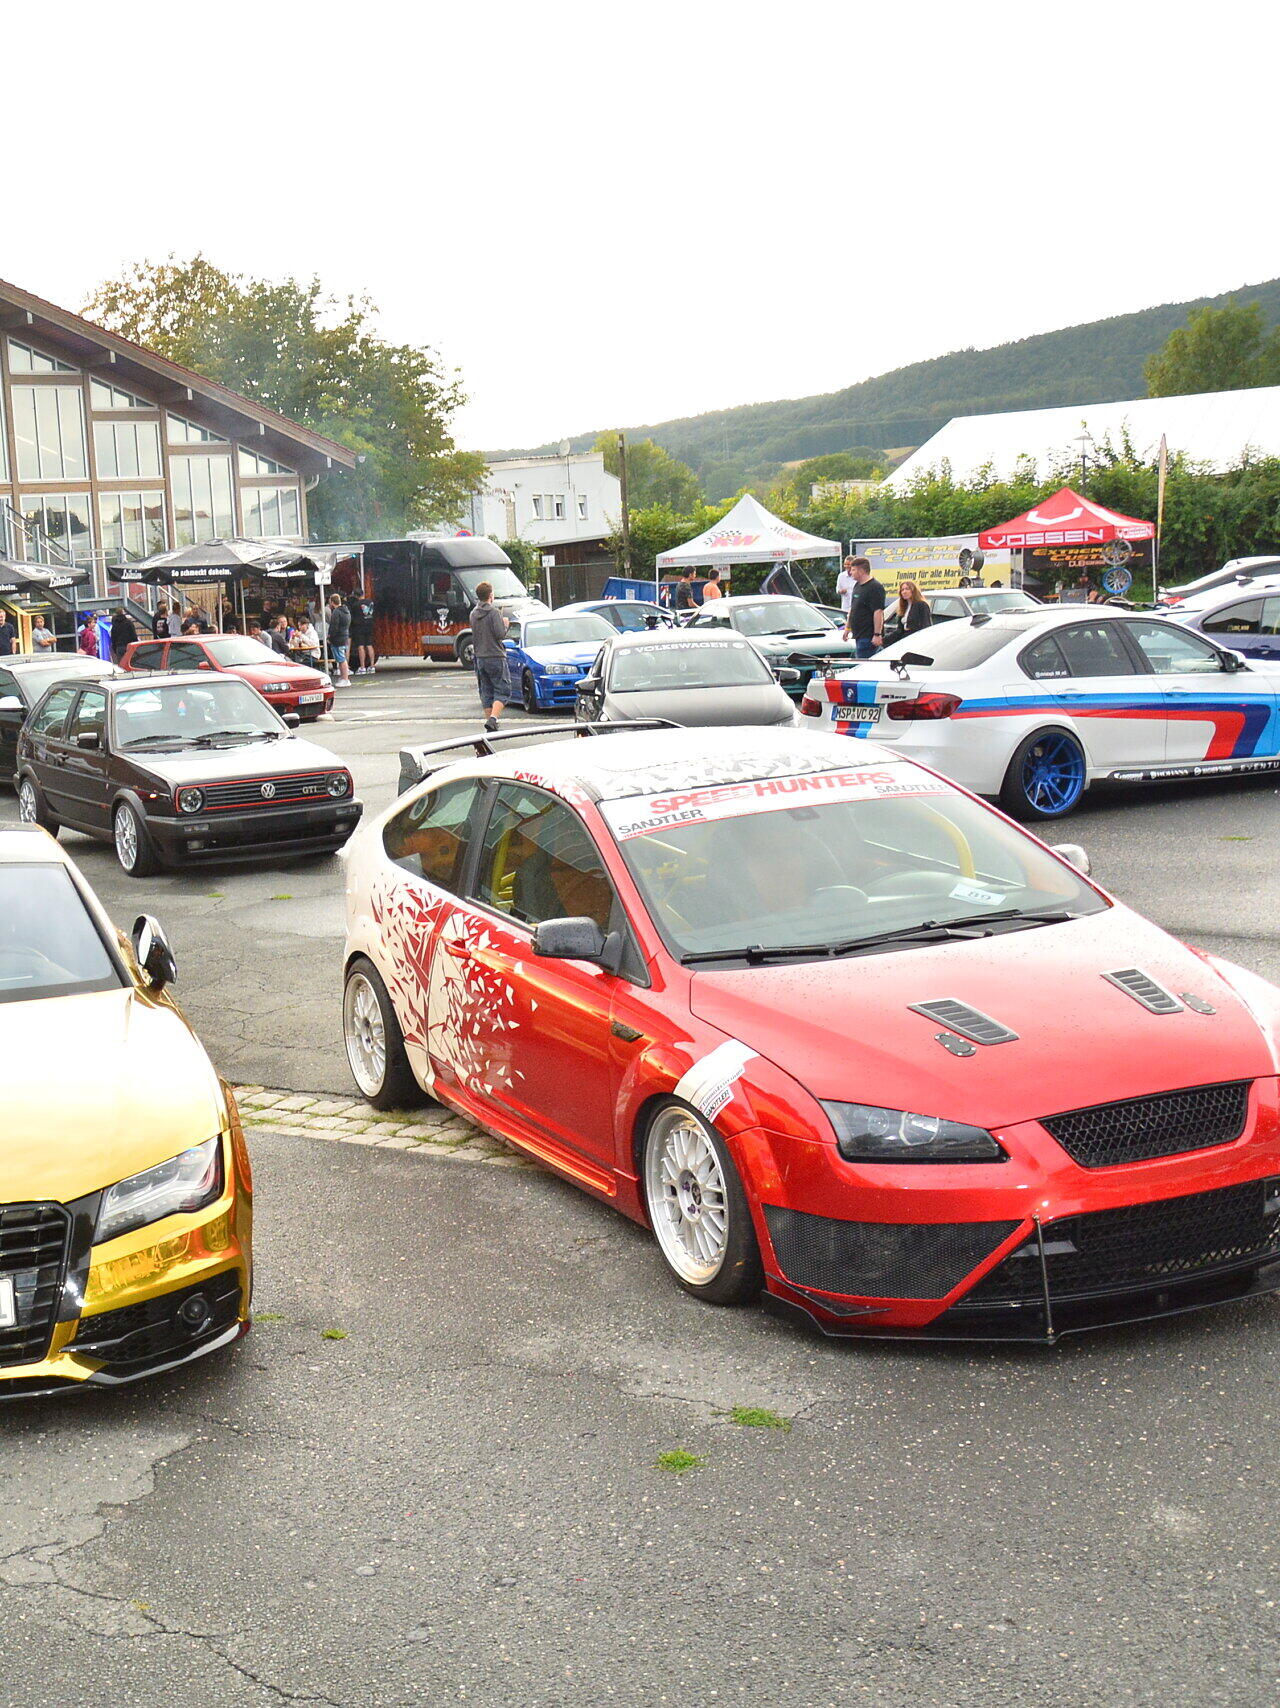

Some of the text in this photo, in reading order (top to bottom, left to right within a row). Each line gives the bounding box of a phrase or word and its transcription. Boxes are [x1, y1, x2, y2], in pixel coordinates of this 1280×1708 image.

[987, 529, 1104, 547] VOSSEN
[1117, 526, 1153, 539] VOSSEN
[896, 571, 917, 580] Tuning
[918, 570, 928, 578] für
[929, 570, 942, 578] alle
[634, 642, 729, 653] VOLKSWAGEN
[835, 707, 879, 720] MSP VC 92
[1240, 761, 1280, 771] EVENTU
[302, 786, 318, 795] GTI
